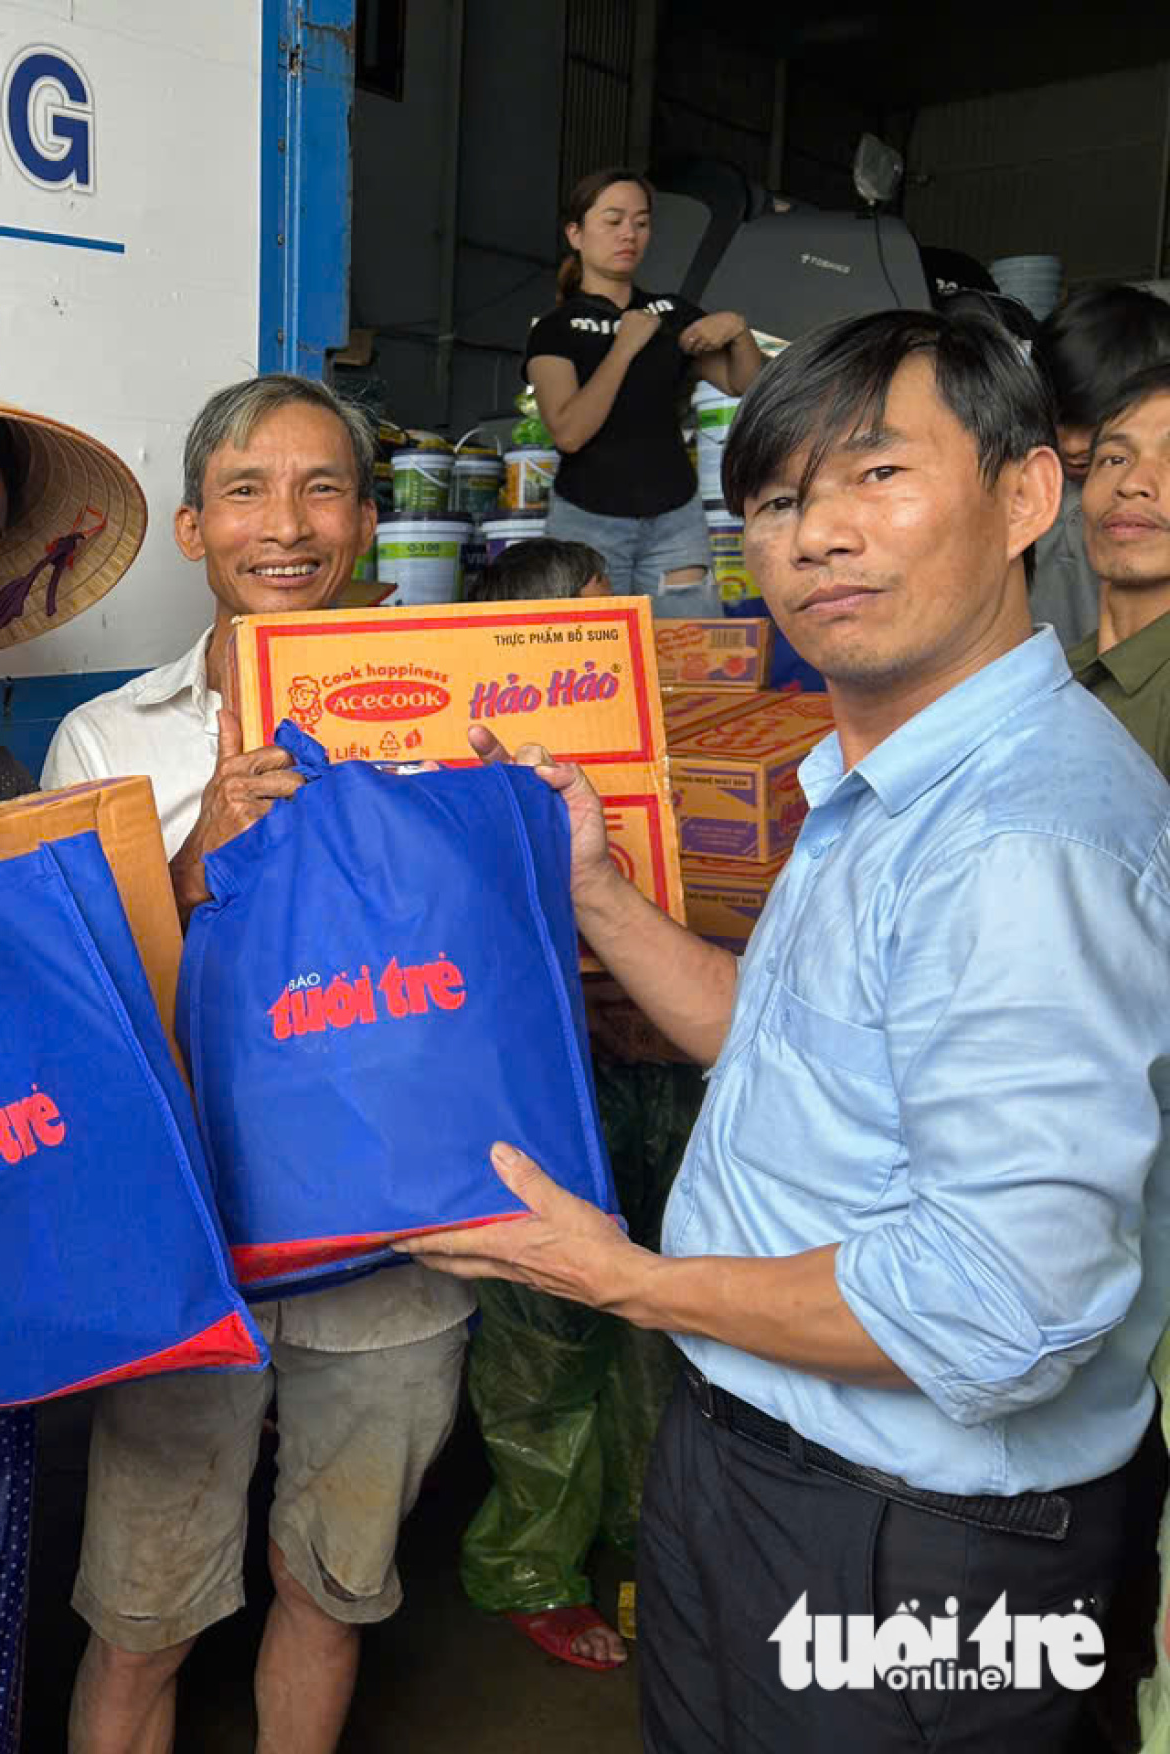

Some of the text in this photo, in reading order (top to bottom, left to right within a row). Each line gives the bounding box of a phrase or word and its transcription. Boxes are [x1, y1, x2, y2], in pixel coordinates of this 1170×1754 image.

[530, 626, 564, 644] PHẨM
[568, 625, 583, 642] BỔ
[587, 628, 619, 642] SUNG
[322, 662, 449, 688] Cook happiness
[468, 660, 619, 720] Hảo Hảo
[378, 950, 468, 1019] trẻ
